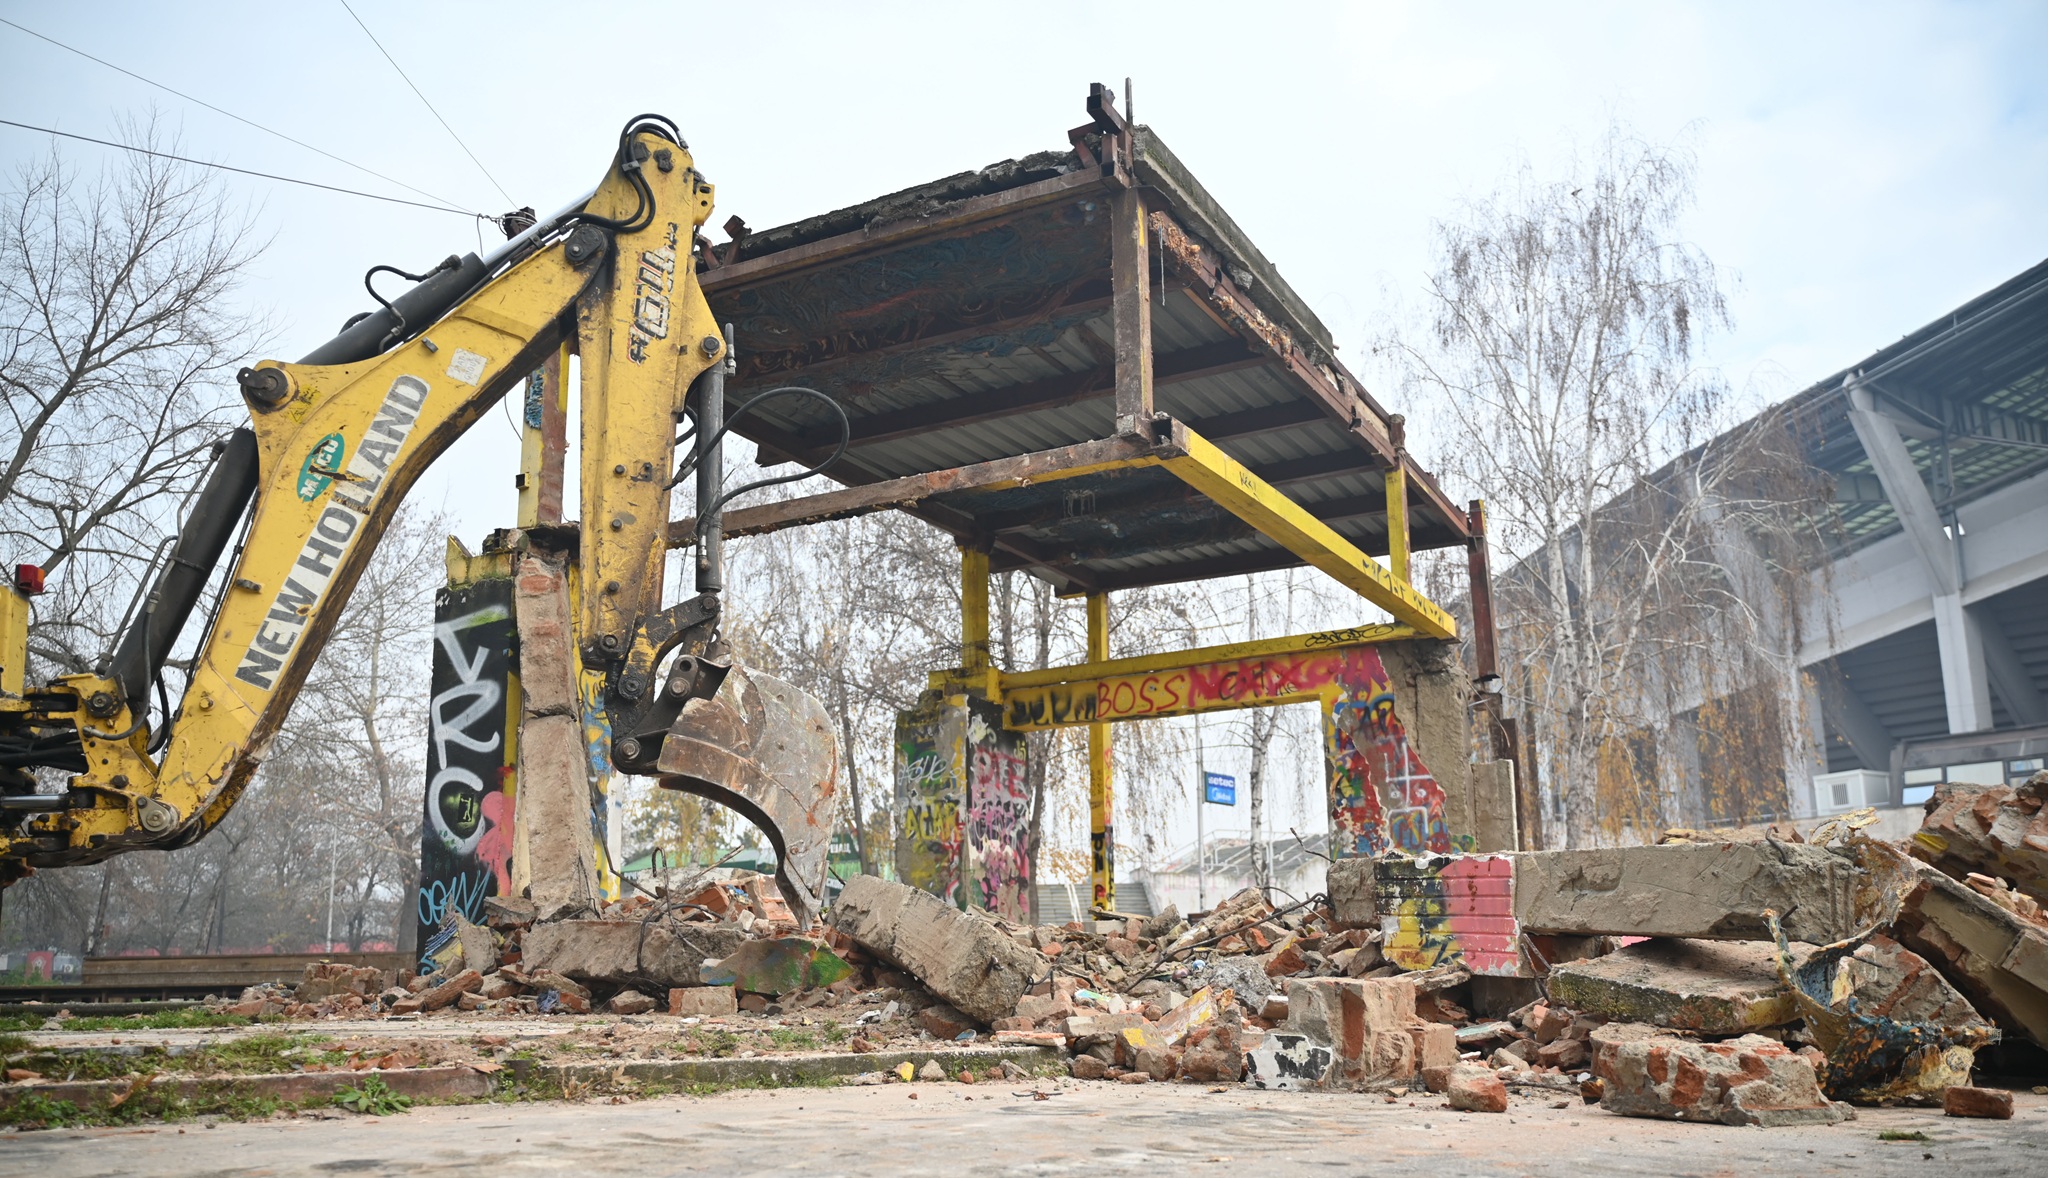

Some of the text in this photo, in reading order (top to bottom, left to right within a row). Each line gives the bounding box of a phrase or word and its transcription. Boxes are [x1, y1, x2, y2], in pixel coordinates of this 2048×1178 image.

[235, 375, 429, 691] NEW HOLLAND
[1096, 674, 1186, 719] BOSS
[1208, 776, 1234, 788] setec
